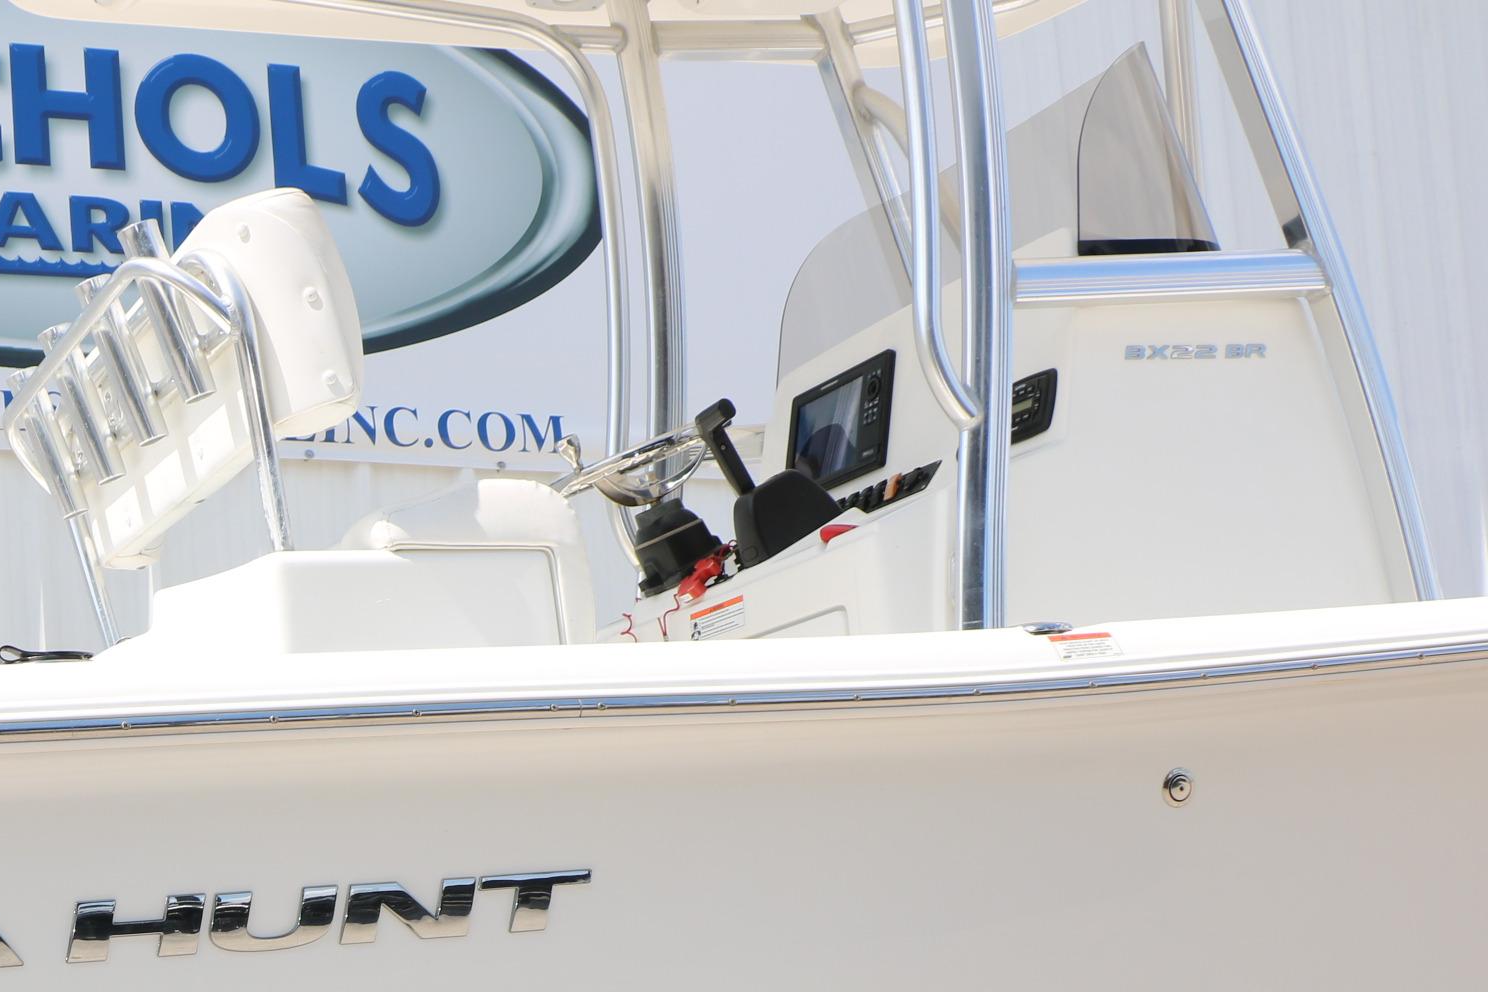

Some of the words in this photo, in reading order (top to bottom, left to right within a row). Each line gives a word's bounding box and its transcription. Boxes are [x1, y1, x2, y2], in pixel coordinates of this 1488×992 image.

[1124, 344, 1218, 360] BX22
[1224, 343, 1267, 359] BR
[65, 869, 591, 963] HUNT
